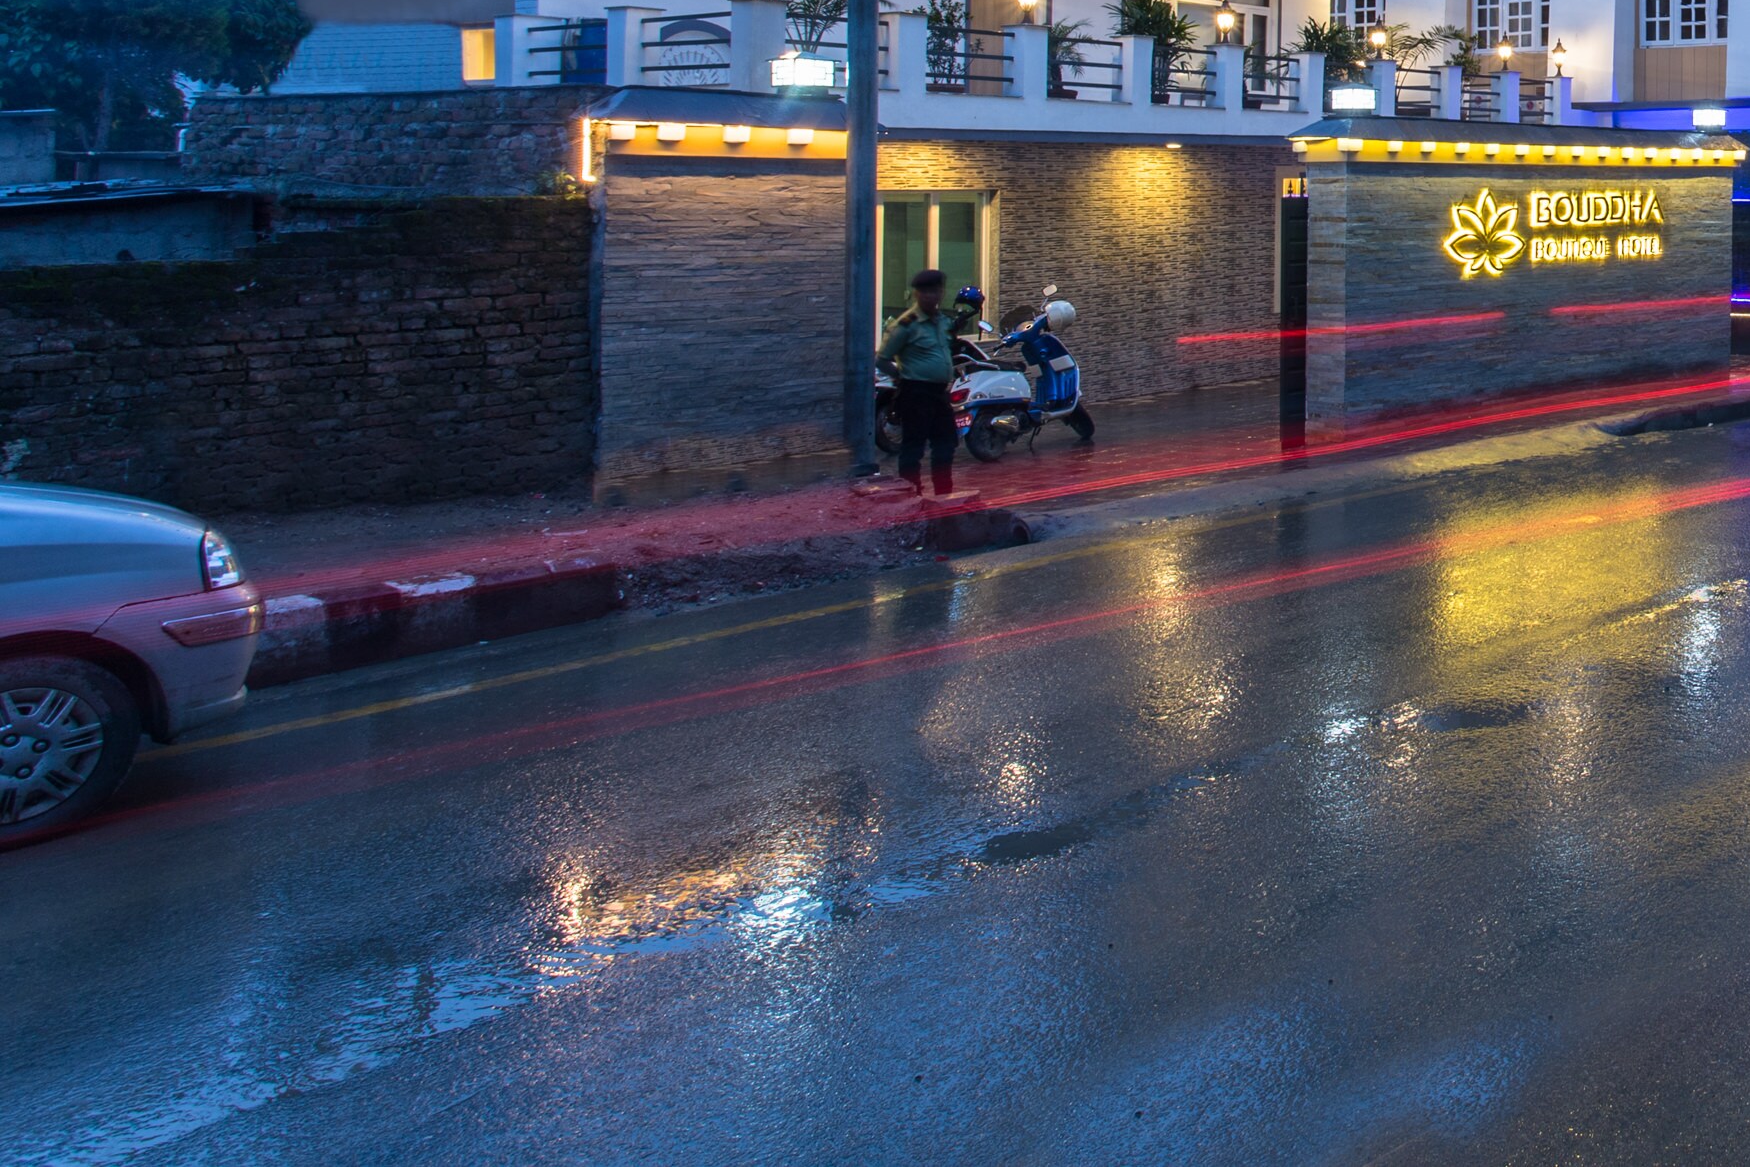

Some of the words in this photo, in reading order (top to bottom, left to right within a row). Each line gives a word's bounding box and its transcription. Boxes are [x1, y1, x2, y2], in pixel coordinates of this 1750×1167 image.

[1531, 191, 1665, 225] BOUDDHA
[1532, 237, 1611, 260] BOUTIQUE
[1617, 236, 1662, 257] HOTEL
